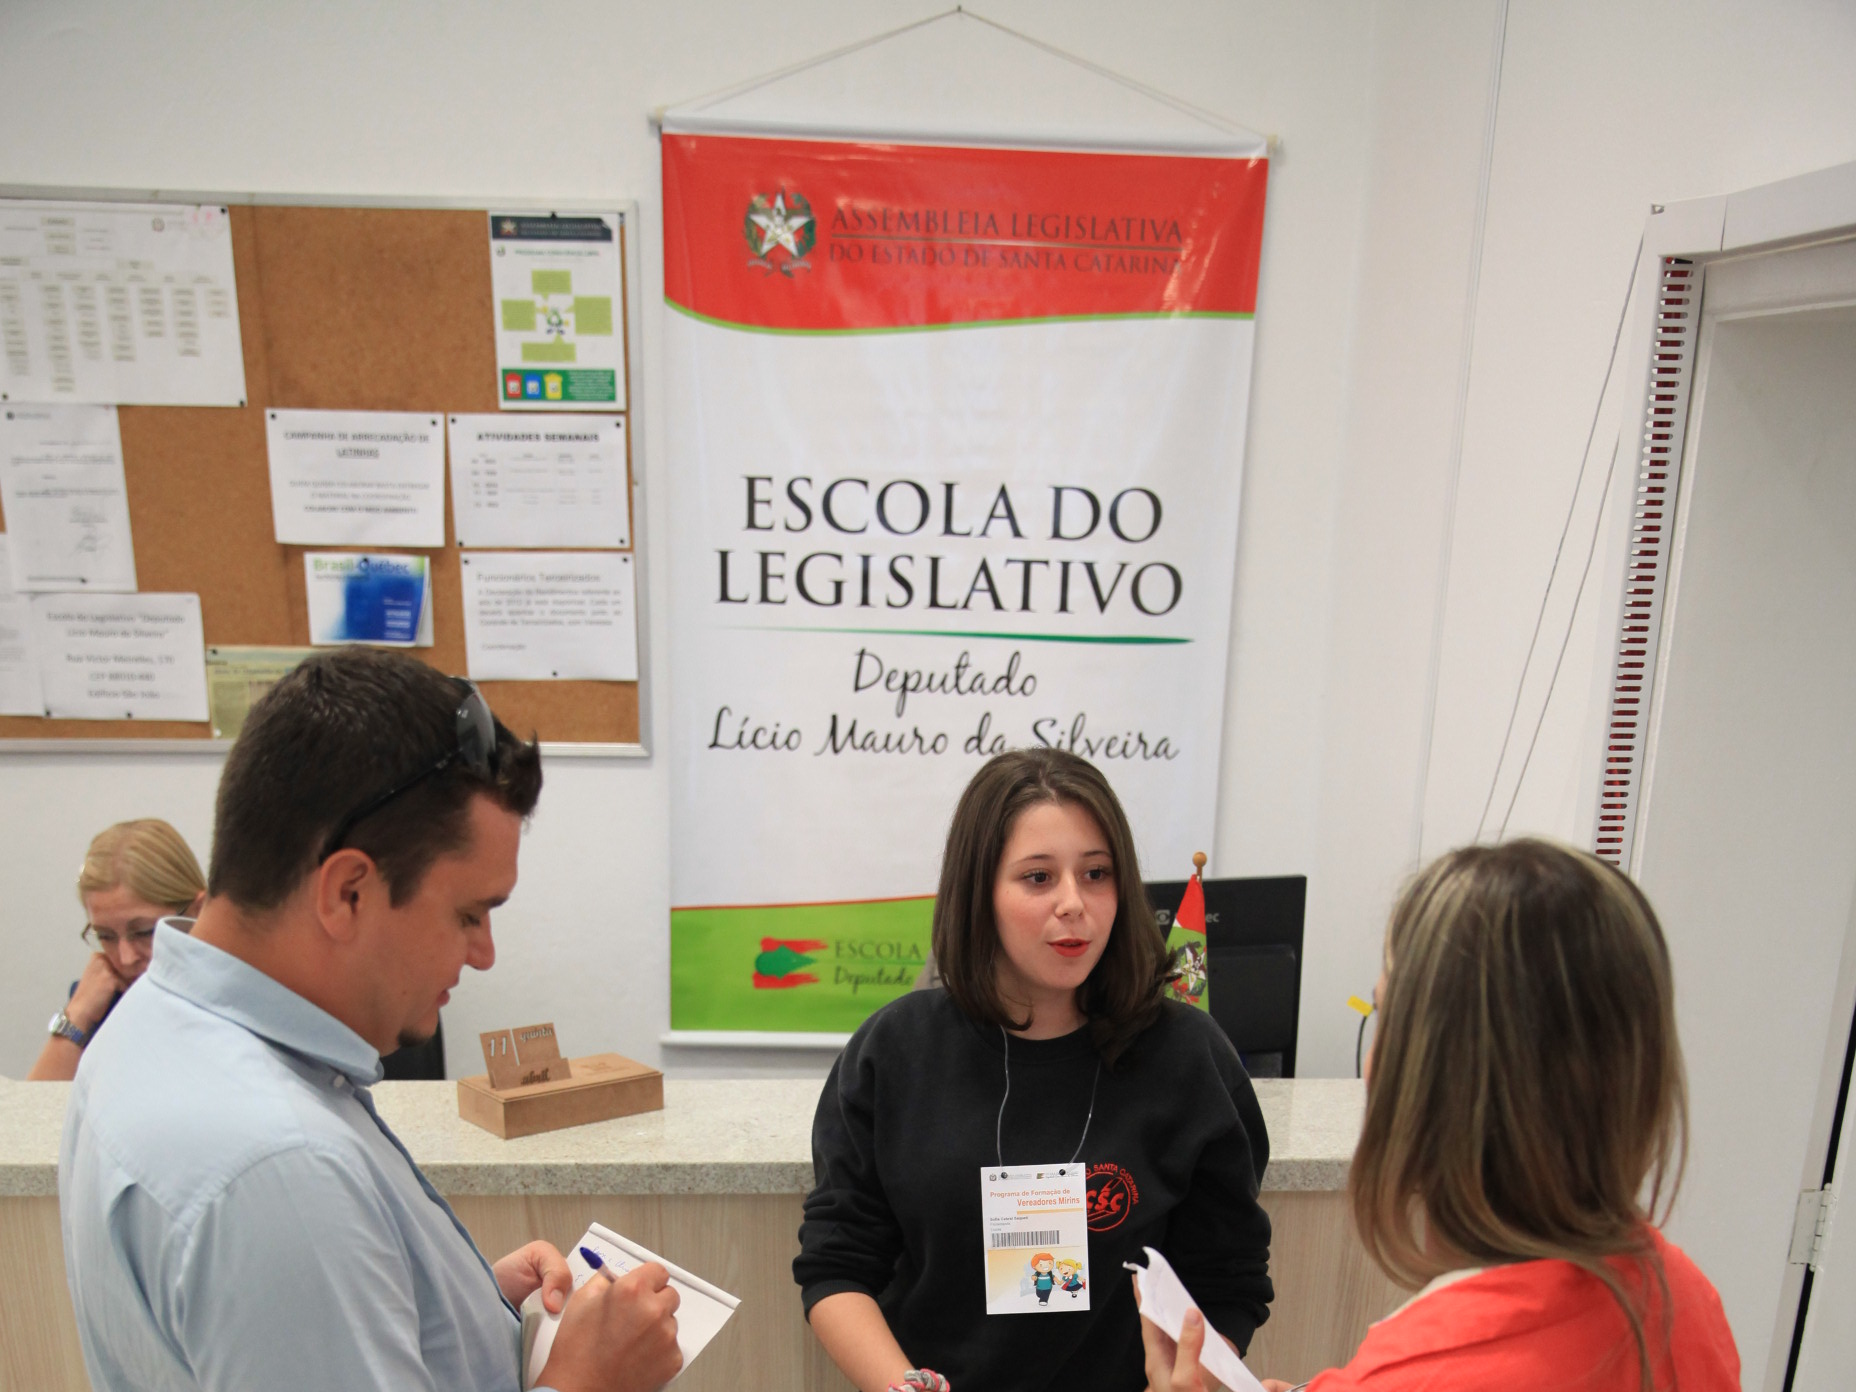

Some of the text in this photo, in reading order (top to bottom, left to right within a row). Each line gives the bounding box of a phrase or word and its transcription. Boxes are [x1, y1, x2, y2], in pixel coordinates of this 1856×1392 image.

[831, 207, 1182, 244] ASSEMBLEIA LEGISLATIVA
[829, 243, 1182, 275] DO ESTADO DE SANTA CATARINA
[476, 432, 600, 442] ATIVIDADES SEMANAIS
[742, 475, 1163, 544] ESCOLA DO
[714, 548, 1183, 617] LEGISLATIVO
[853, 647, 1037, 718] Deputado
[708, 705, 1181, 761] Lício Mauro da Silveira
[835, 940, 922, 960] ESCOLA
[834, 965, 913, 995] Deputado
[520, 1026, 553, 1043] quinta
[990, 1191, 1020, 1199] Programa
[1031, 1189, 1061, 1198] Formação
[1093, 1162, 1139, 1206] SANTA CATARINA
[1017, 1196, 1080, 1207] Vereadores Mirins
